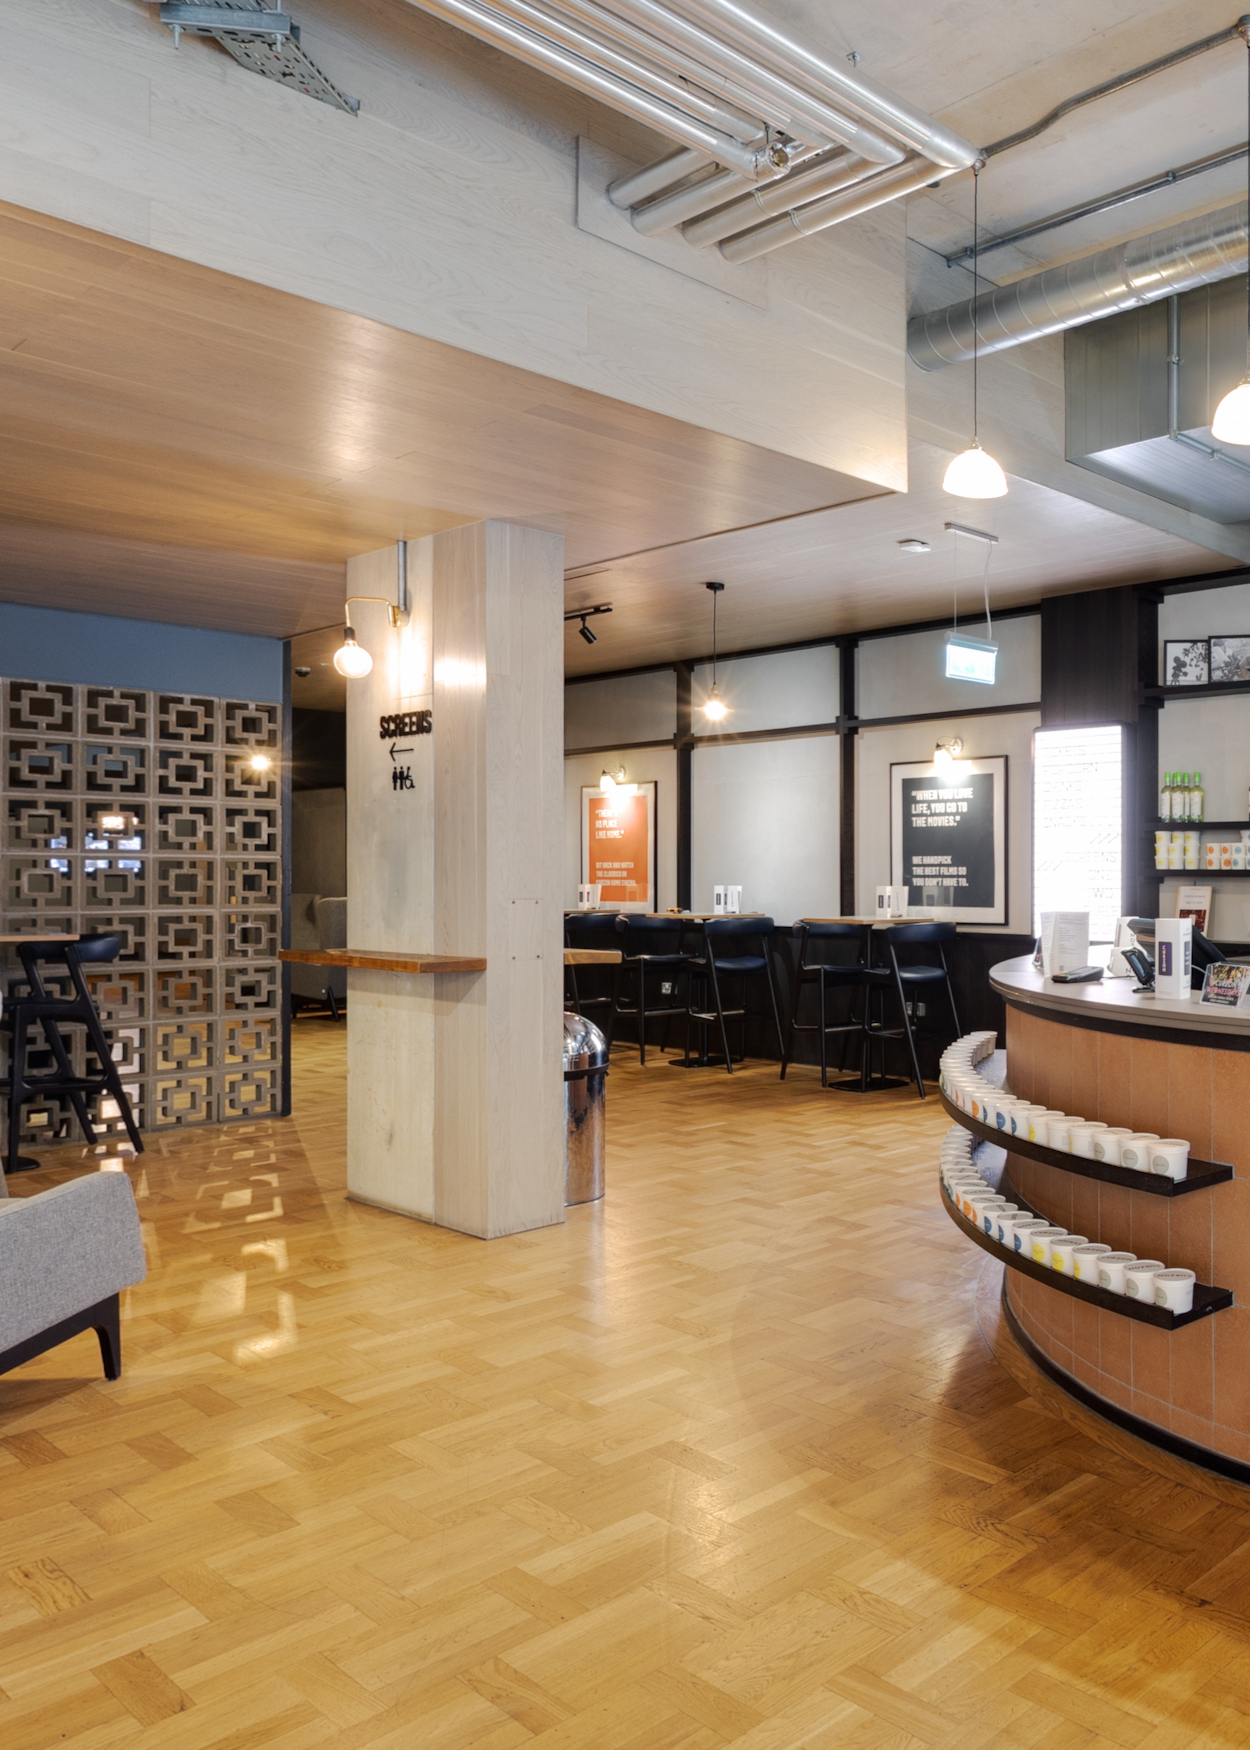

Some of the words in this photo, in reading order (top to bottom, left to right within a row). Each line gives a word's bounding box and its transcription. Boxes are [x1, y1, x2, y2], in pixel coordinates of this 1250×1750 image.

[380, 709, 432, 739] SCREENS
[911, 803, 930, 815] LIFE,
[930, 802, 946, 813] YOU
[946, 802, 957, 813] GO
[957, 801, 968, 812] TO
[911, 817, 927, 827] THE
[912, 867, 924, 875] THE
